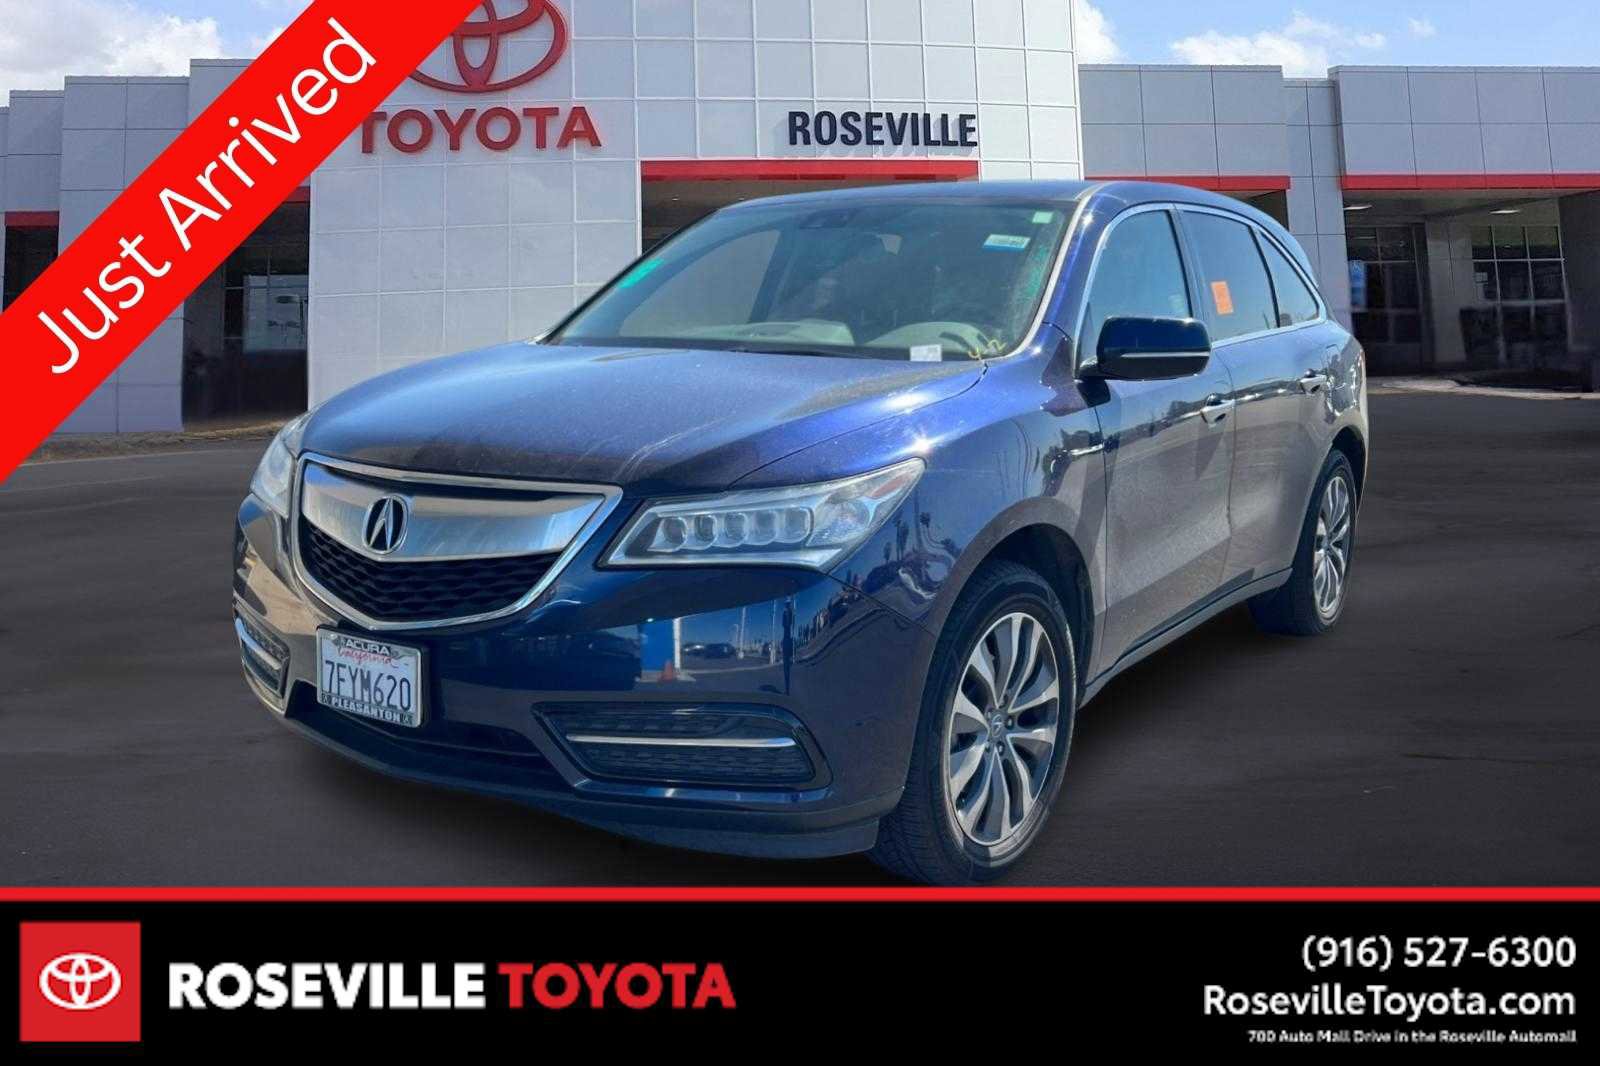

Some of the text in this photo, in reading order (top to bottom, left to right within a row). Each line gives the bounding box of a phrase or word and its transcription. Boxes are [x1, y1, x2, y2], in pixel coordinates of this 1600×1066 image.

[360, 106, 602, 153] TOYOTA
[788, 110, 978, 147] ROSEVILLE
[345, 638, 391, 657] ACURA
[324, 660, 412, 712] 7FYM620
[331, 696, 401, 722] PLEASANTON
